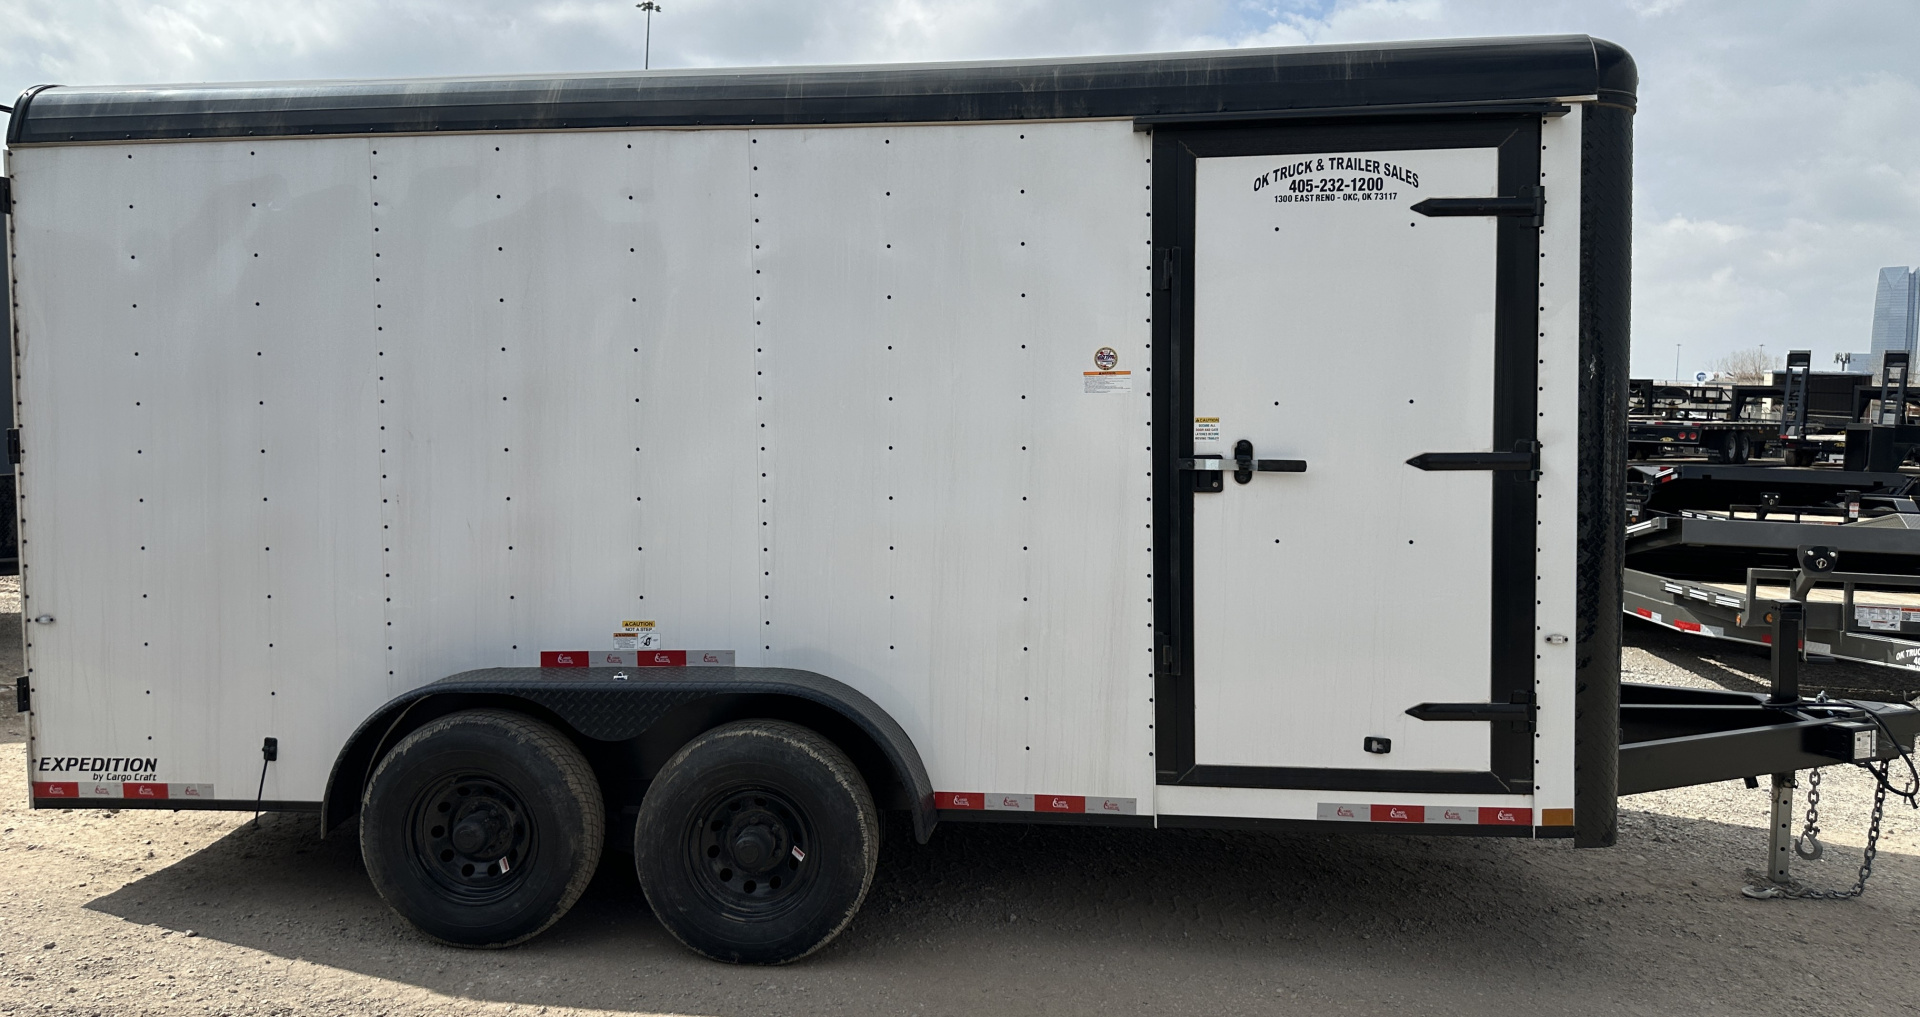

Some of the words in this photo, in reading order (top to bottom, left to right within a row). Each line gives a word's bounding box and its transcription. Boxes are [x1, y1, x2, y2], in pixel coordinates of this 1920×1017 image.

[1254, 172, 1269, 191] OK
[1273, 160, 1313, 182] TRUCK
[1316, 158, 1324, 171] &
[1329, 157, 1380, 174] TRAILER
[1384, 163, 1419, 188] SALES
[1289, 177, 1383, 193] 405-232-1200
[1275, 195, 1293, 203] 1300
[1295, 194, 1314, 202] EAST
[1316, 193, 1335, 202] RENO
[1343, 193, 1360, 202] OKC,
[1362, 193, 1372, 201] OK
[1375, 192, 1397, 200] 73117
[1896, 651, 1905, 660] OK
[39, 757, 158, 773] EXPEDITION
[93, 773, 104, 782] by
[106, 773, 132, 782] Cargo
[134, 773, 157, 782] Craft
